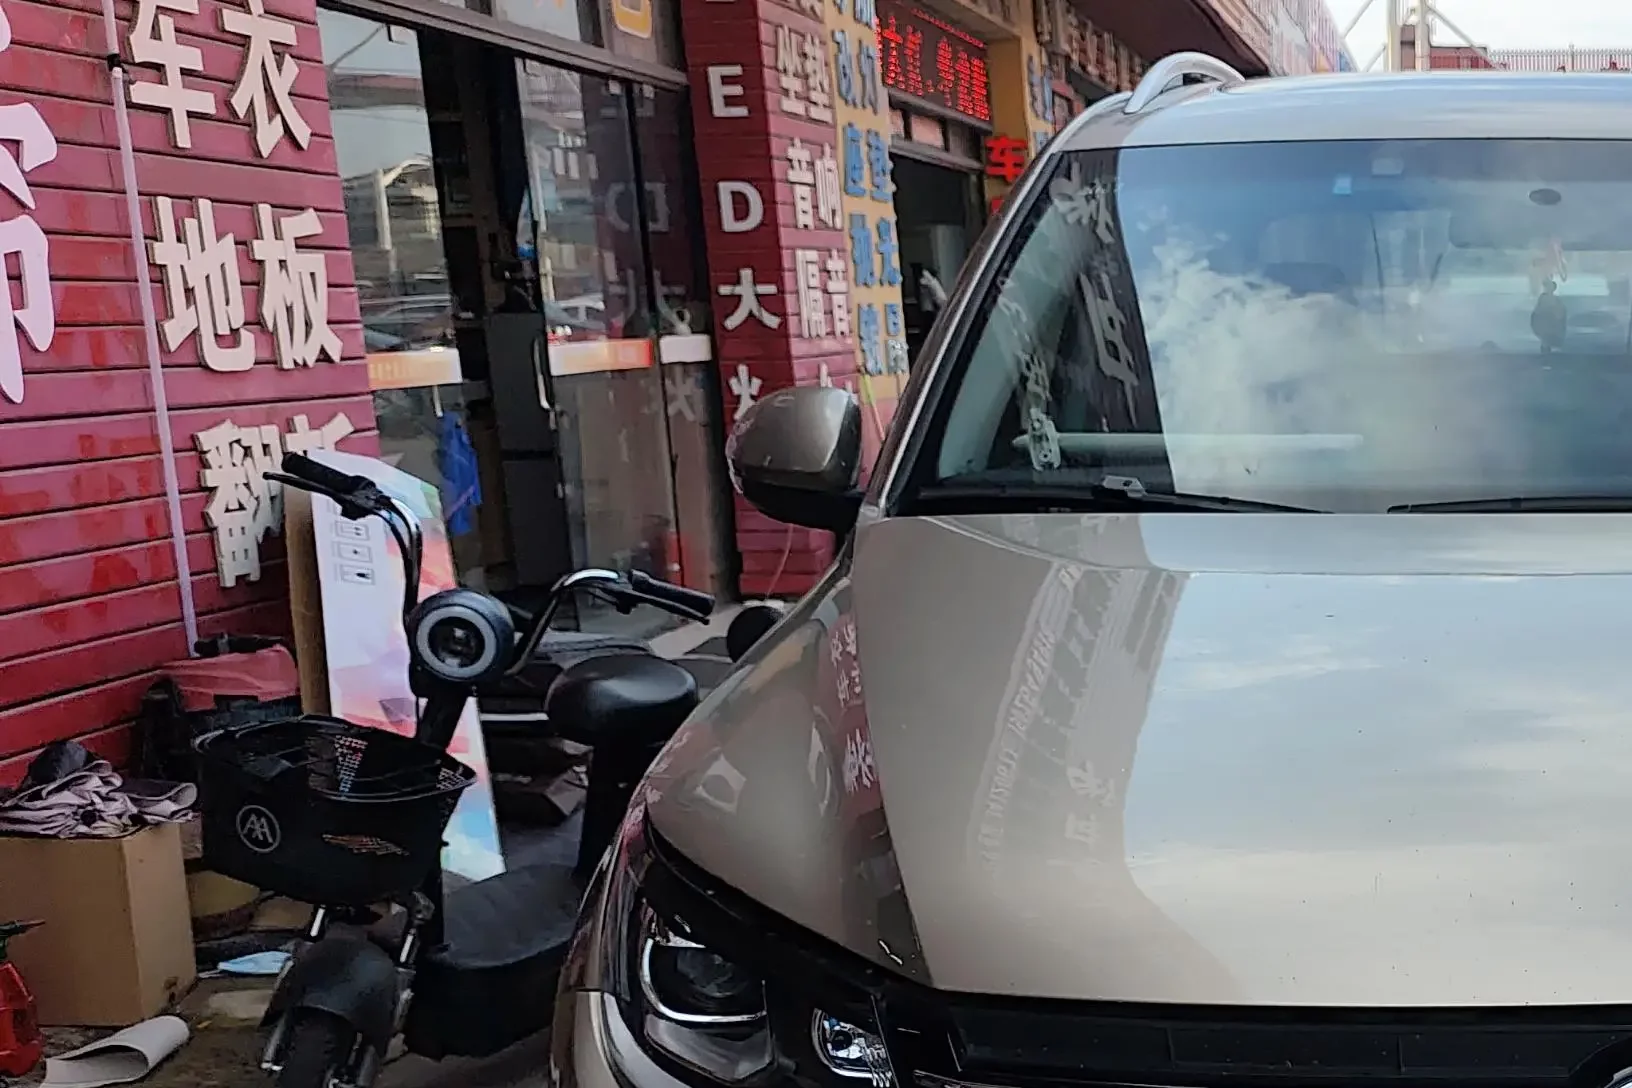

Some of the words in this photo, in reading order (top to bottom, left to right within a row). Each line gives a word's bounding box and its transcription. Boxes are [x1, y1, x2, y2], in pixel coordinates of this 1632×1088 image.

[125, 0, 314, 159] 车衣
[148, 194, 343, 373] 地板
[193, 411, 355, 589] 翻
